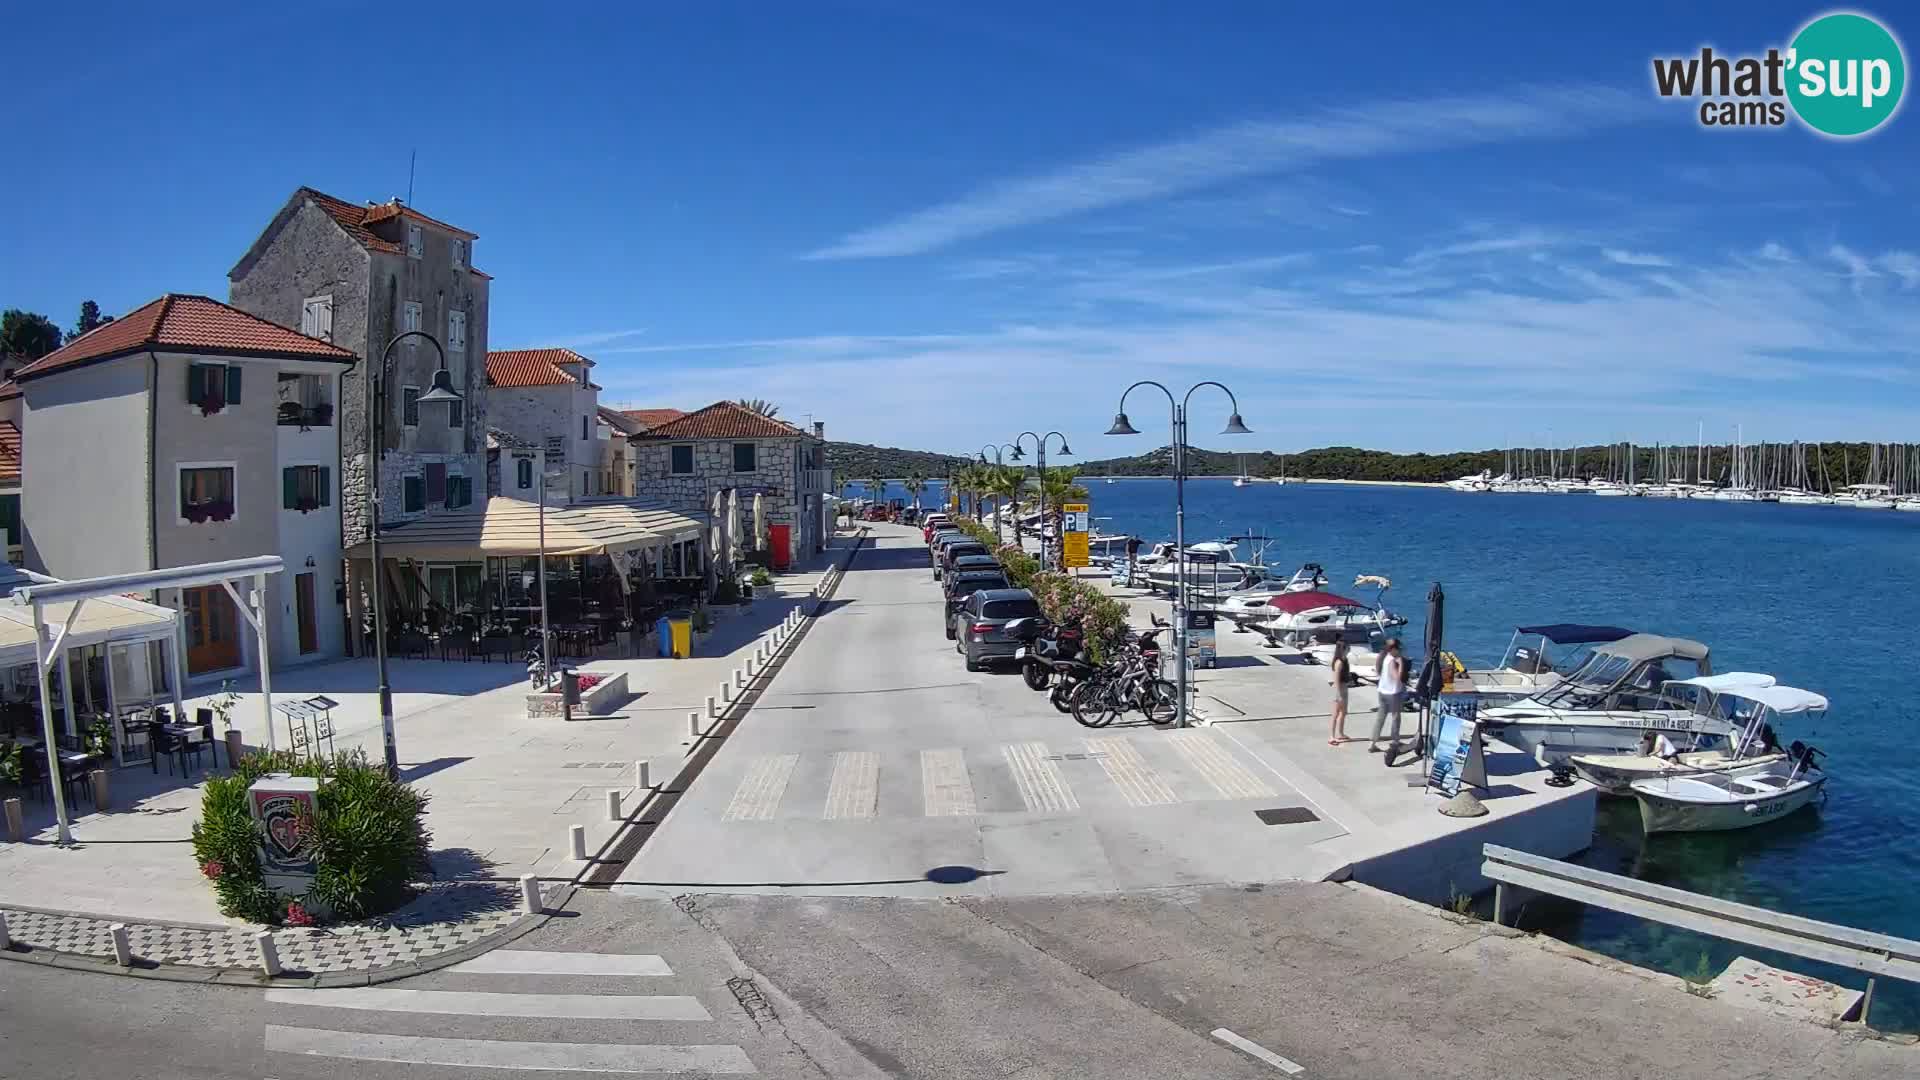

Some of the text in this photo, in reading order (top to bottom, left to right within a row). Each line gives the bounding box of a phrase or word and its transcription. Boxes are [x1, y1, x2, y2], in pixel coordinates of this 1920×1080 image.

[1065, 514, 1076, 530] P
[1652, 720, 1669, 729] RENT
[1677, 720, 1693, 730] BOAT
